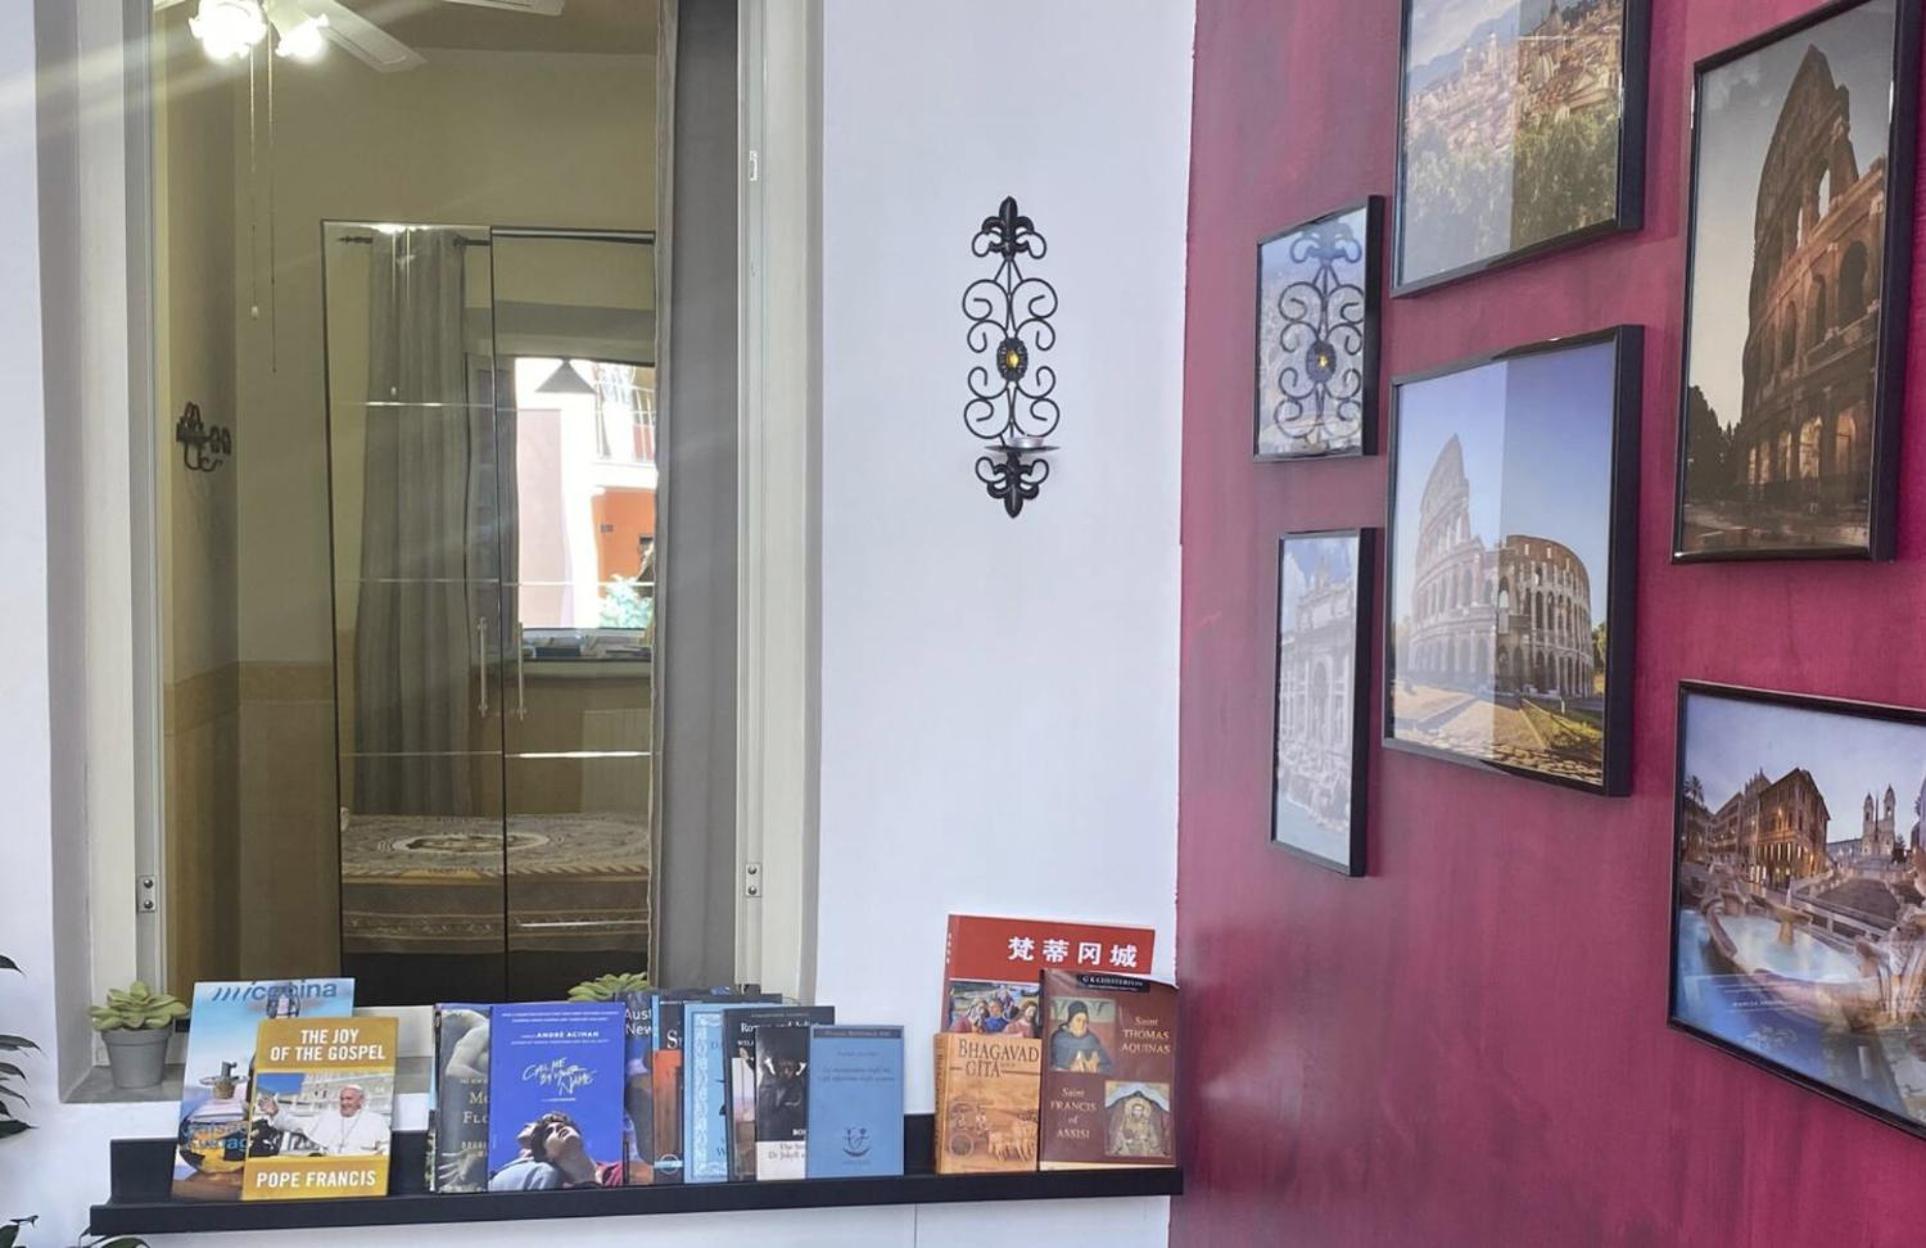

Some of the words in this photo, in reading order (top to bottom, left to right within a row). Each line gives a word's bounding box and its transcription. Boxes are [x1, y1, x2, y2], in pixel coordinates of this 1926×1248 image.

[1008, 936, 1137, 967] 梵蒂冈城
[301, 1029, 328, 1045] THE
[332, 1028, 359, 1044] JOY
[1122, 1029, 1170, 1040] THOMAS
[270, 1046, 290, 1061] OF
[296, 1046, 322, 1061] THE
[328, 1044, 386, 1061] GOSPEL
[958, 1038, 1040, 1062] BHAGAVAD
[1121, 1042, 1171, 1055] AQUINAS
[965, 1061, 1001, 1078] GITA
[1050, 1100, 1097, 1112] FRANCIS
[256, 1171, 301, 1188] POPE
[305, 1170, 376, 1188] FRANCIS
